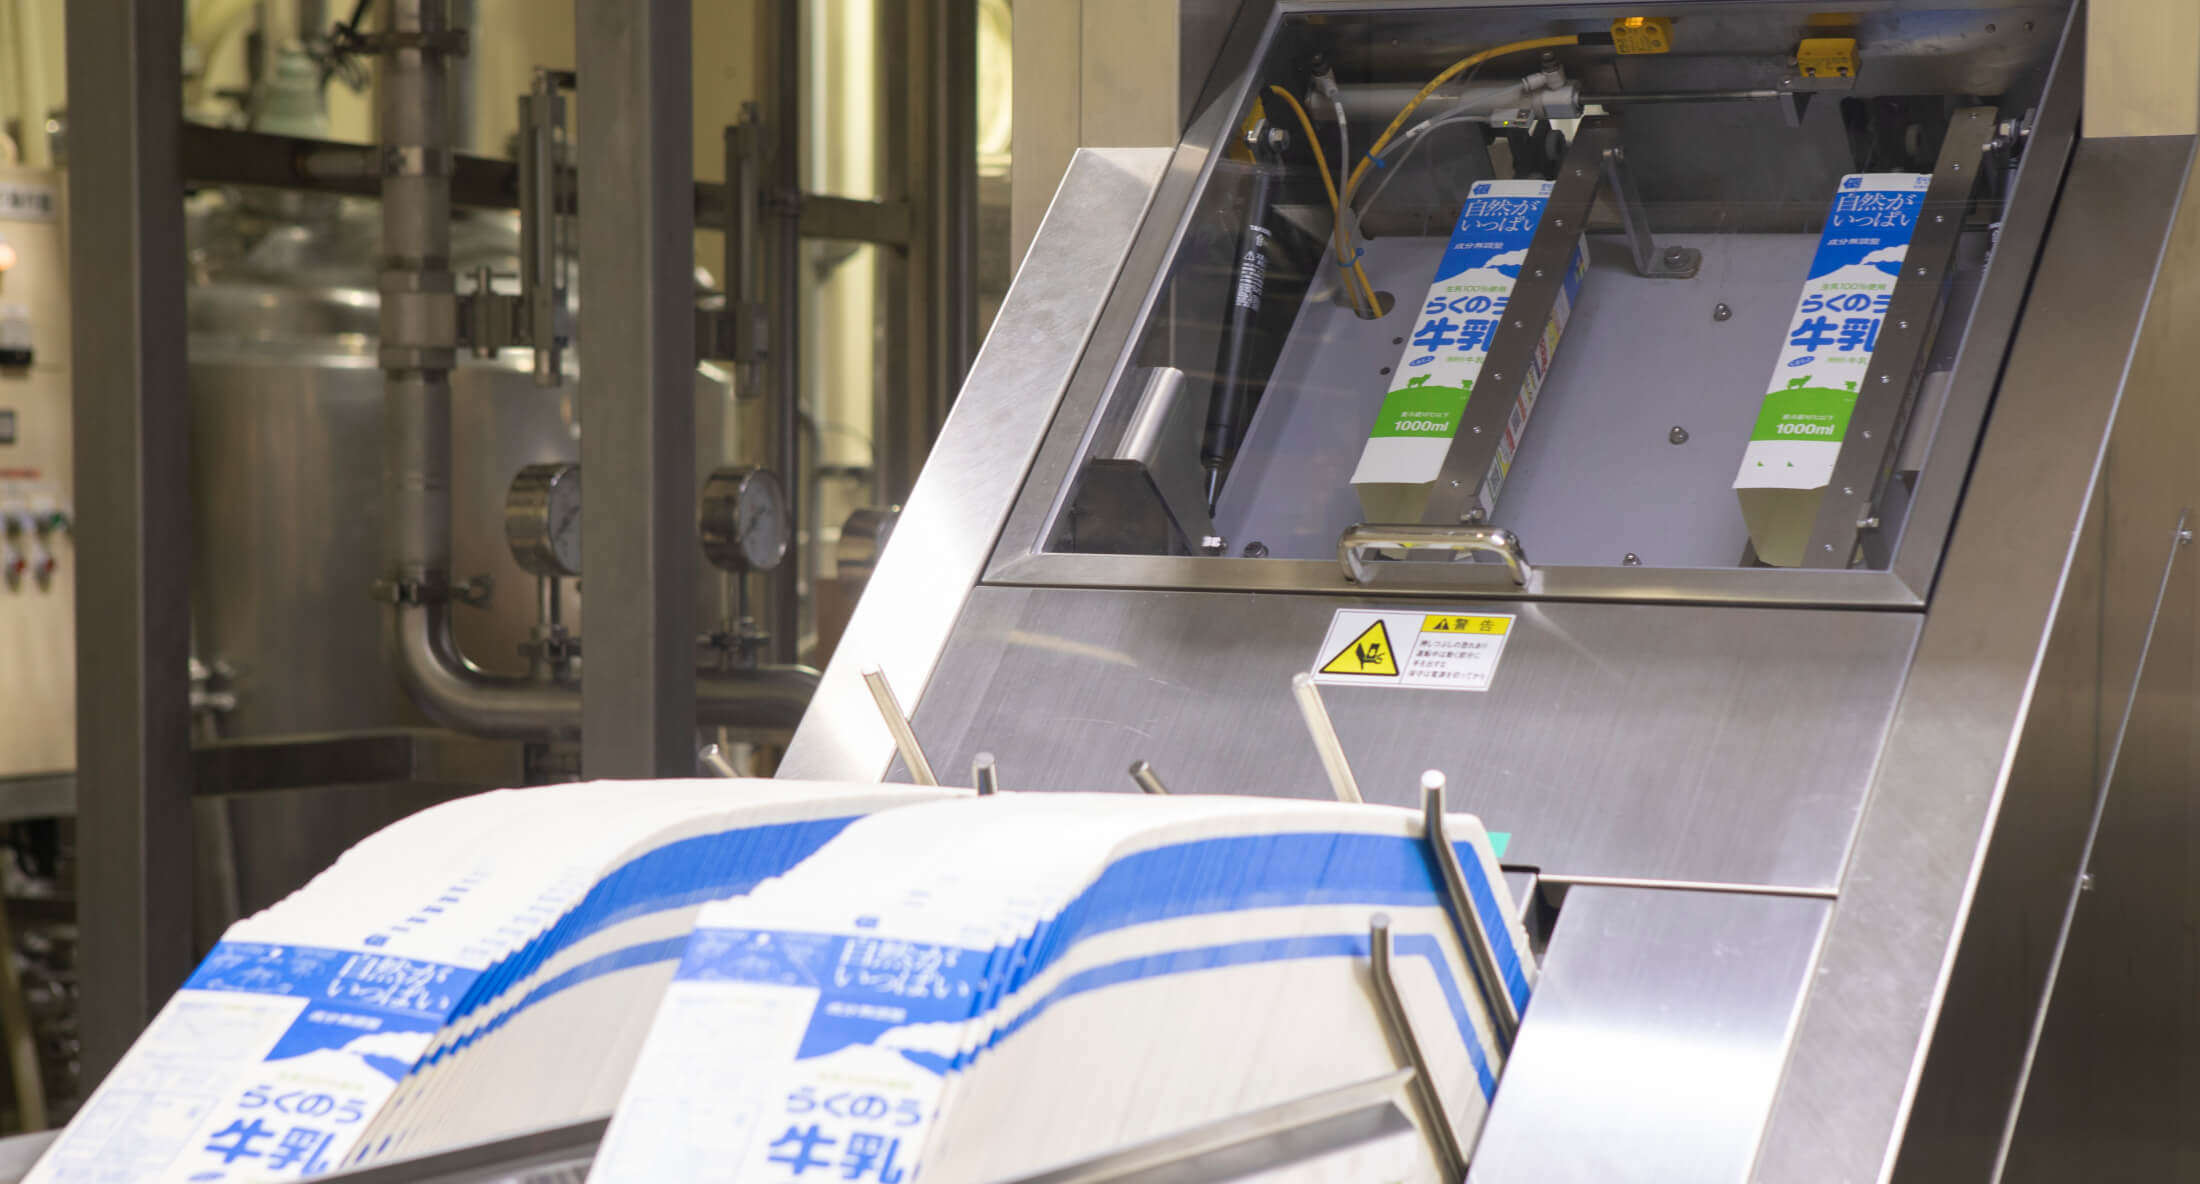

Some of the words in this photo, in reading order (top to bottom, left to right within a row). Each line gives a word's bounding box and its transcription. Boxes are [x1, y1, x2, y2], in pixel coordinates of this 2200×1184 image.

[1465, 199, 1541, 217] 自然が
[1837, 192, 1917, 212] 自然が
[1413, 316, 1498, 352] 牛乳
[1789, 315, 1880, 352] 牛乳
[1394, 420, 1449, 432] 1000ml
[1776, 423, 1835, 435] 1000ml
[1455, 618, 1495, 632] 警告
[339, 953, 454, 985] 自然が
[839, 936, 962, 972] 自然が
[327, 972, 450, 1011] いっぱい
[834, 962, 970, 999] いっぱい
[238, 1084, 368, 1124] らくのう
[785, 1086, 923, 1127] らくのう
[205, 1118, 335, 1177] 牛乳
[767, 1123, 904, 1184] 牛乳
